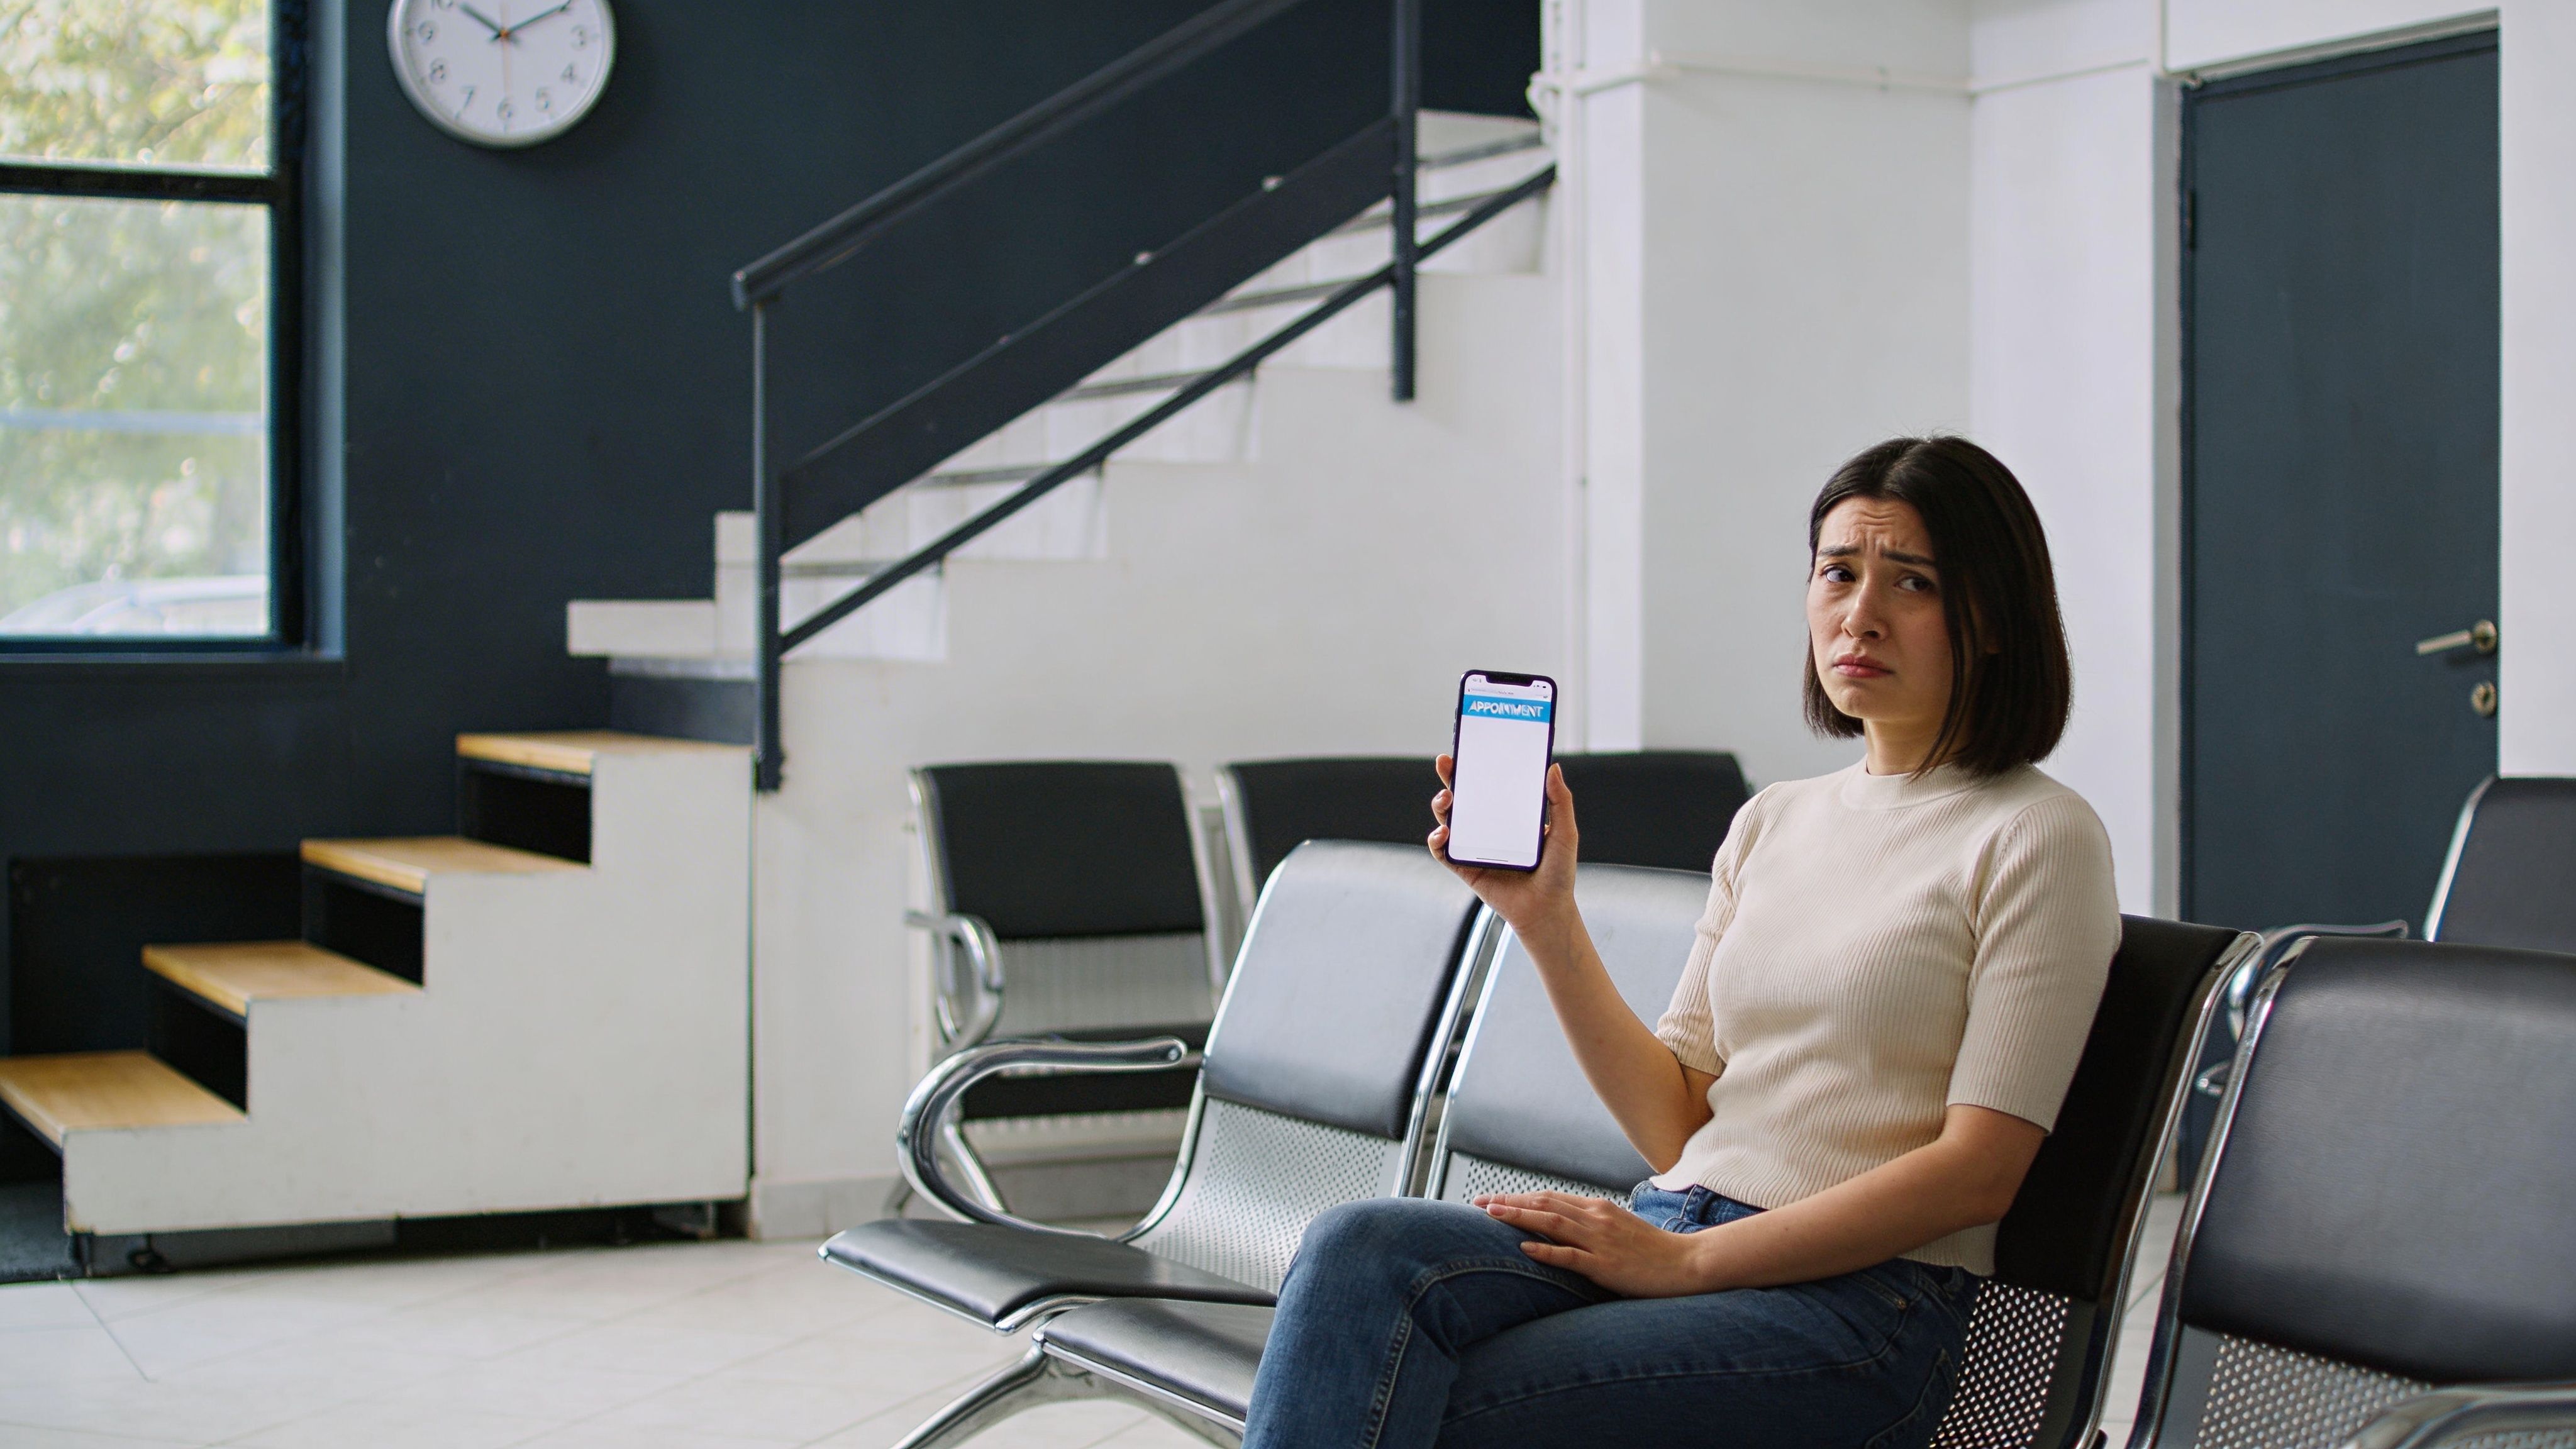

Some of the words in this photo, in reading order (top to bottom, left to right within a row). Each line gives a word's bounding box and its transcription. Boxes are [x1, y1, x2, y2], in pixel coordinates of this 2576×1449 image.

[418, 20, 435, 45] 9
[570, 25, 586, 51] 3
[429, 58, 447, 84] 8
[560, 62, 575, 86] 4
[460, 85, 476, 110] 7
[497, 97, 514, 120] 6
[535, 87, 552, 112] 5
